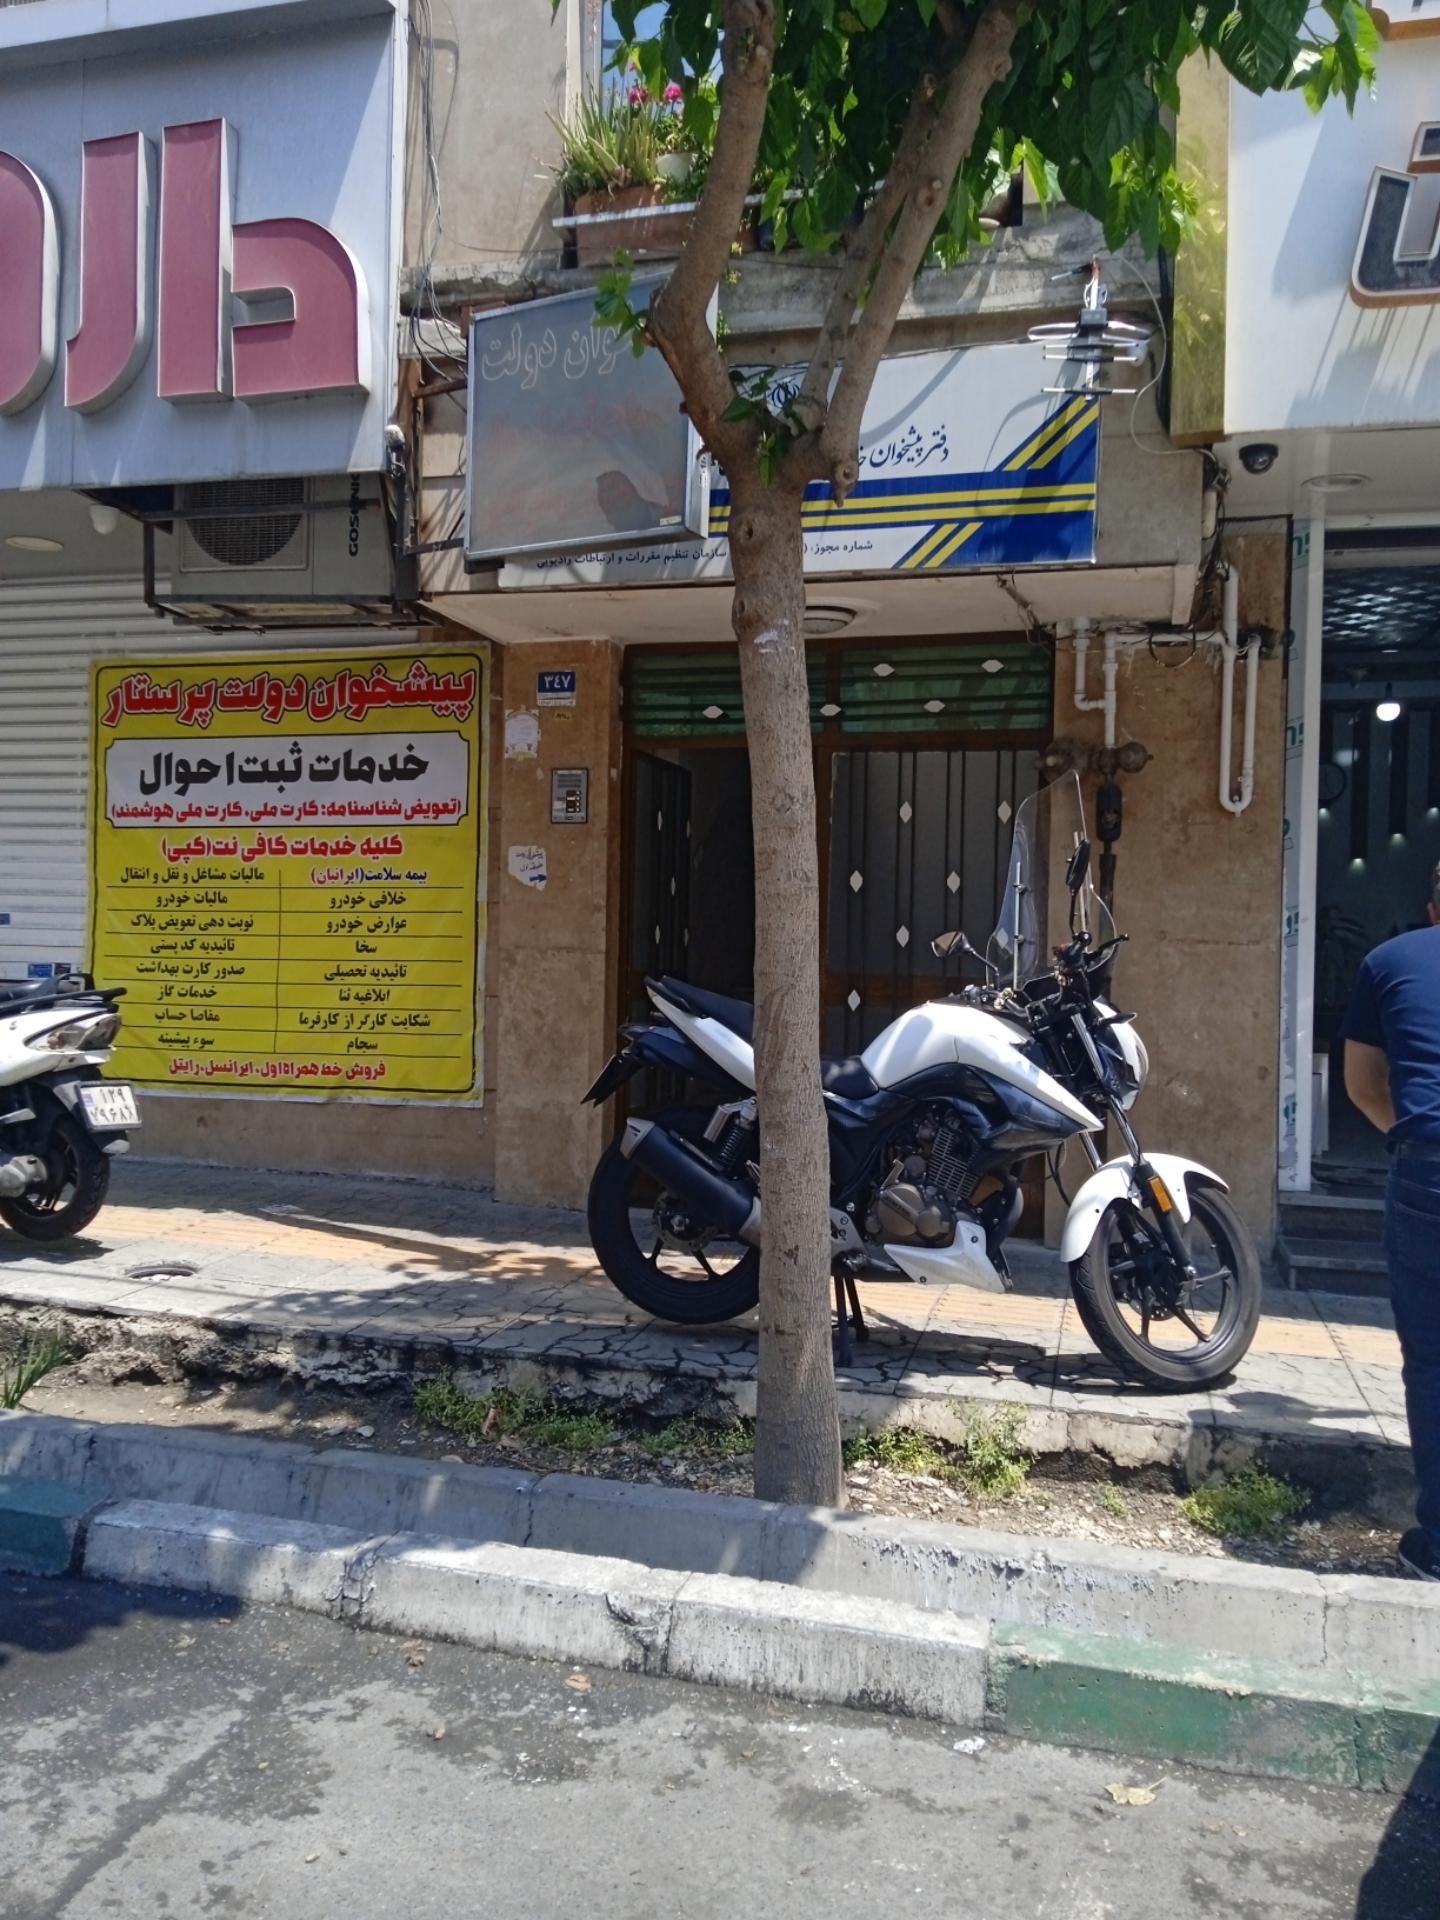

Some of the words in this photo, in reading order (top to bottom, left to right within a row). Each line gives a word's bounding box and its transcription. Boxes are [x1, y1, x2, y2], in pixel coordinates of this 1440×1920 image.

[870, 425, 923, 468] پیشخوان
[915, 424, 949, 469] دفتر
[843, 541, 872, 552] شماره
[574, 553, 615, 564] ارتباطات
[618, 556, 622, 564] و
[626, 552, 661, 563] مقررات
[664, 549, 689, 565] تنظیم
[217, 672, 307, 723] دولت
[307, 661, 474, 722] پیشخوان
[101, 674, 216, 728] پرستار
[238, 741, 302, 793] ثبت
[309, 744, 429, 784] خدمات
[140, 752, 234, 796] احوال
[176, 802, 202, 823] ملی
[205, 801, 242, 823] کارت
[281, 799, 318, 822] کارت
[321, 799, 402, 816] شناسنامه:
[242, 836, 287, 862] کافی
[291, 835, 356, 856] خدمات
[361, 835, 402, 859] کلیه
[121, 867, 149, 883] انتقال
[153, 873, 158, 884] و
[163, 868, 179, 883] نقل
[183, 873, 188, 884] و
[194, 868, 226, 883] مشاغل
[233, 868, 264, 880] مالیات
[404, 870, 427, 883] بیمه
[156, 892, 194, 907] خودرو
[195, 891, 227, 904] مالیات
[330, 892, 365, 909] خودرو
[369, 891, 406, 909] خلافی
[131, 914, 155, 930] پلاک
[159, 915, 195, 931] تعویض
[199, 918, 224, 931] دهی
[228, 918, 253, 932] نوبت
[327, 919, 363, 933] خودرو
[367, 917, 406, 933] عوارض
[151, 940, 177, 954] پستی
[181, 939, 196, 950] کد
[356, 941, 377, 953] سخا
[136, 961, 179, 976] بهداشت
[183, 962, 211, 978] کارت
[214, 966, 245, 979] صدور
[324, 965, 367, 981] تحصیلی
[178, 985, 217, 998] خدمات
[354, 989, 390, 1005] ابلاغیه
[155, 1008, 186, 1020] حساب
[299, 1012, 339, 1029] کارفرما
[344, 1013, 354, 1029] از
[392, 1014, 430, 1029] شکایت
[158, 1033, 190, 1048] پیشینه
[347, 1038, 377, 1053] سجام
[321, 1064, 342, 1075] خط
[346, 1063, 385, 1080] فروش
